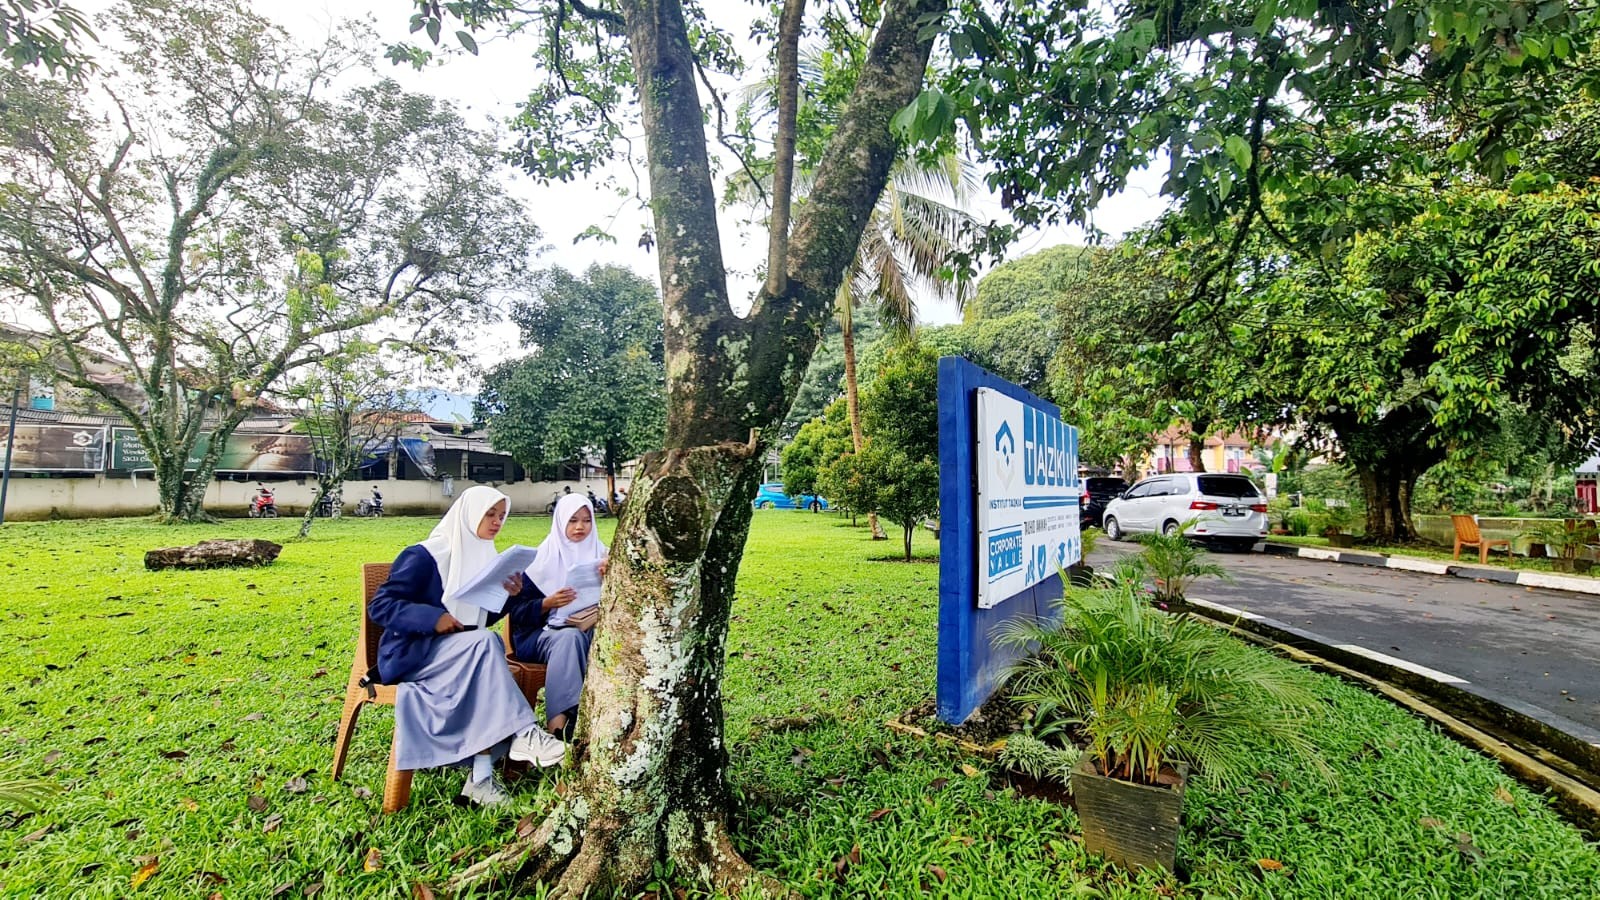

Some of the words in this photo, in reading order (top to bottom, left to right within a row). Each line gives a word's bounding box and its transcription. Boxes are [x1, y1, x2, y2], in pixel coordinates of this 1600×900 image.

[1025, 439, 1078, 480] TAZKIA
[990, 535, 1022, 556] CORPORATE
[990, 550, 1022, 573] VALUE
